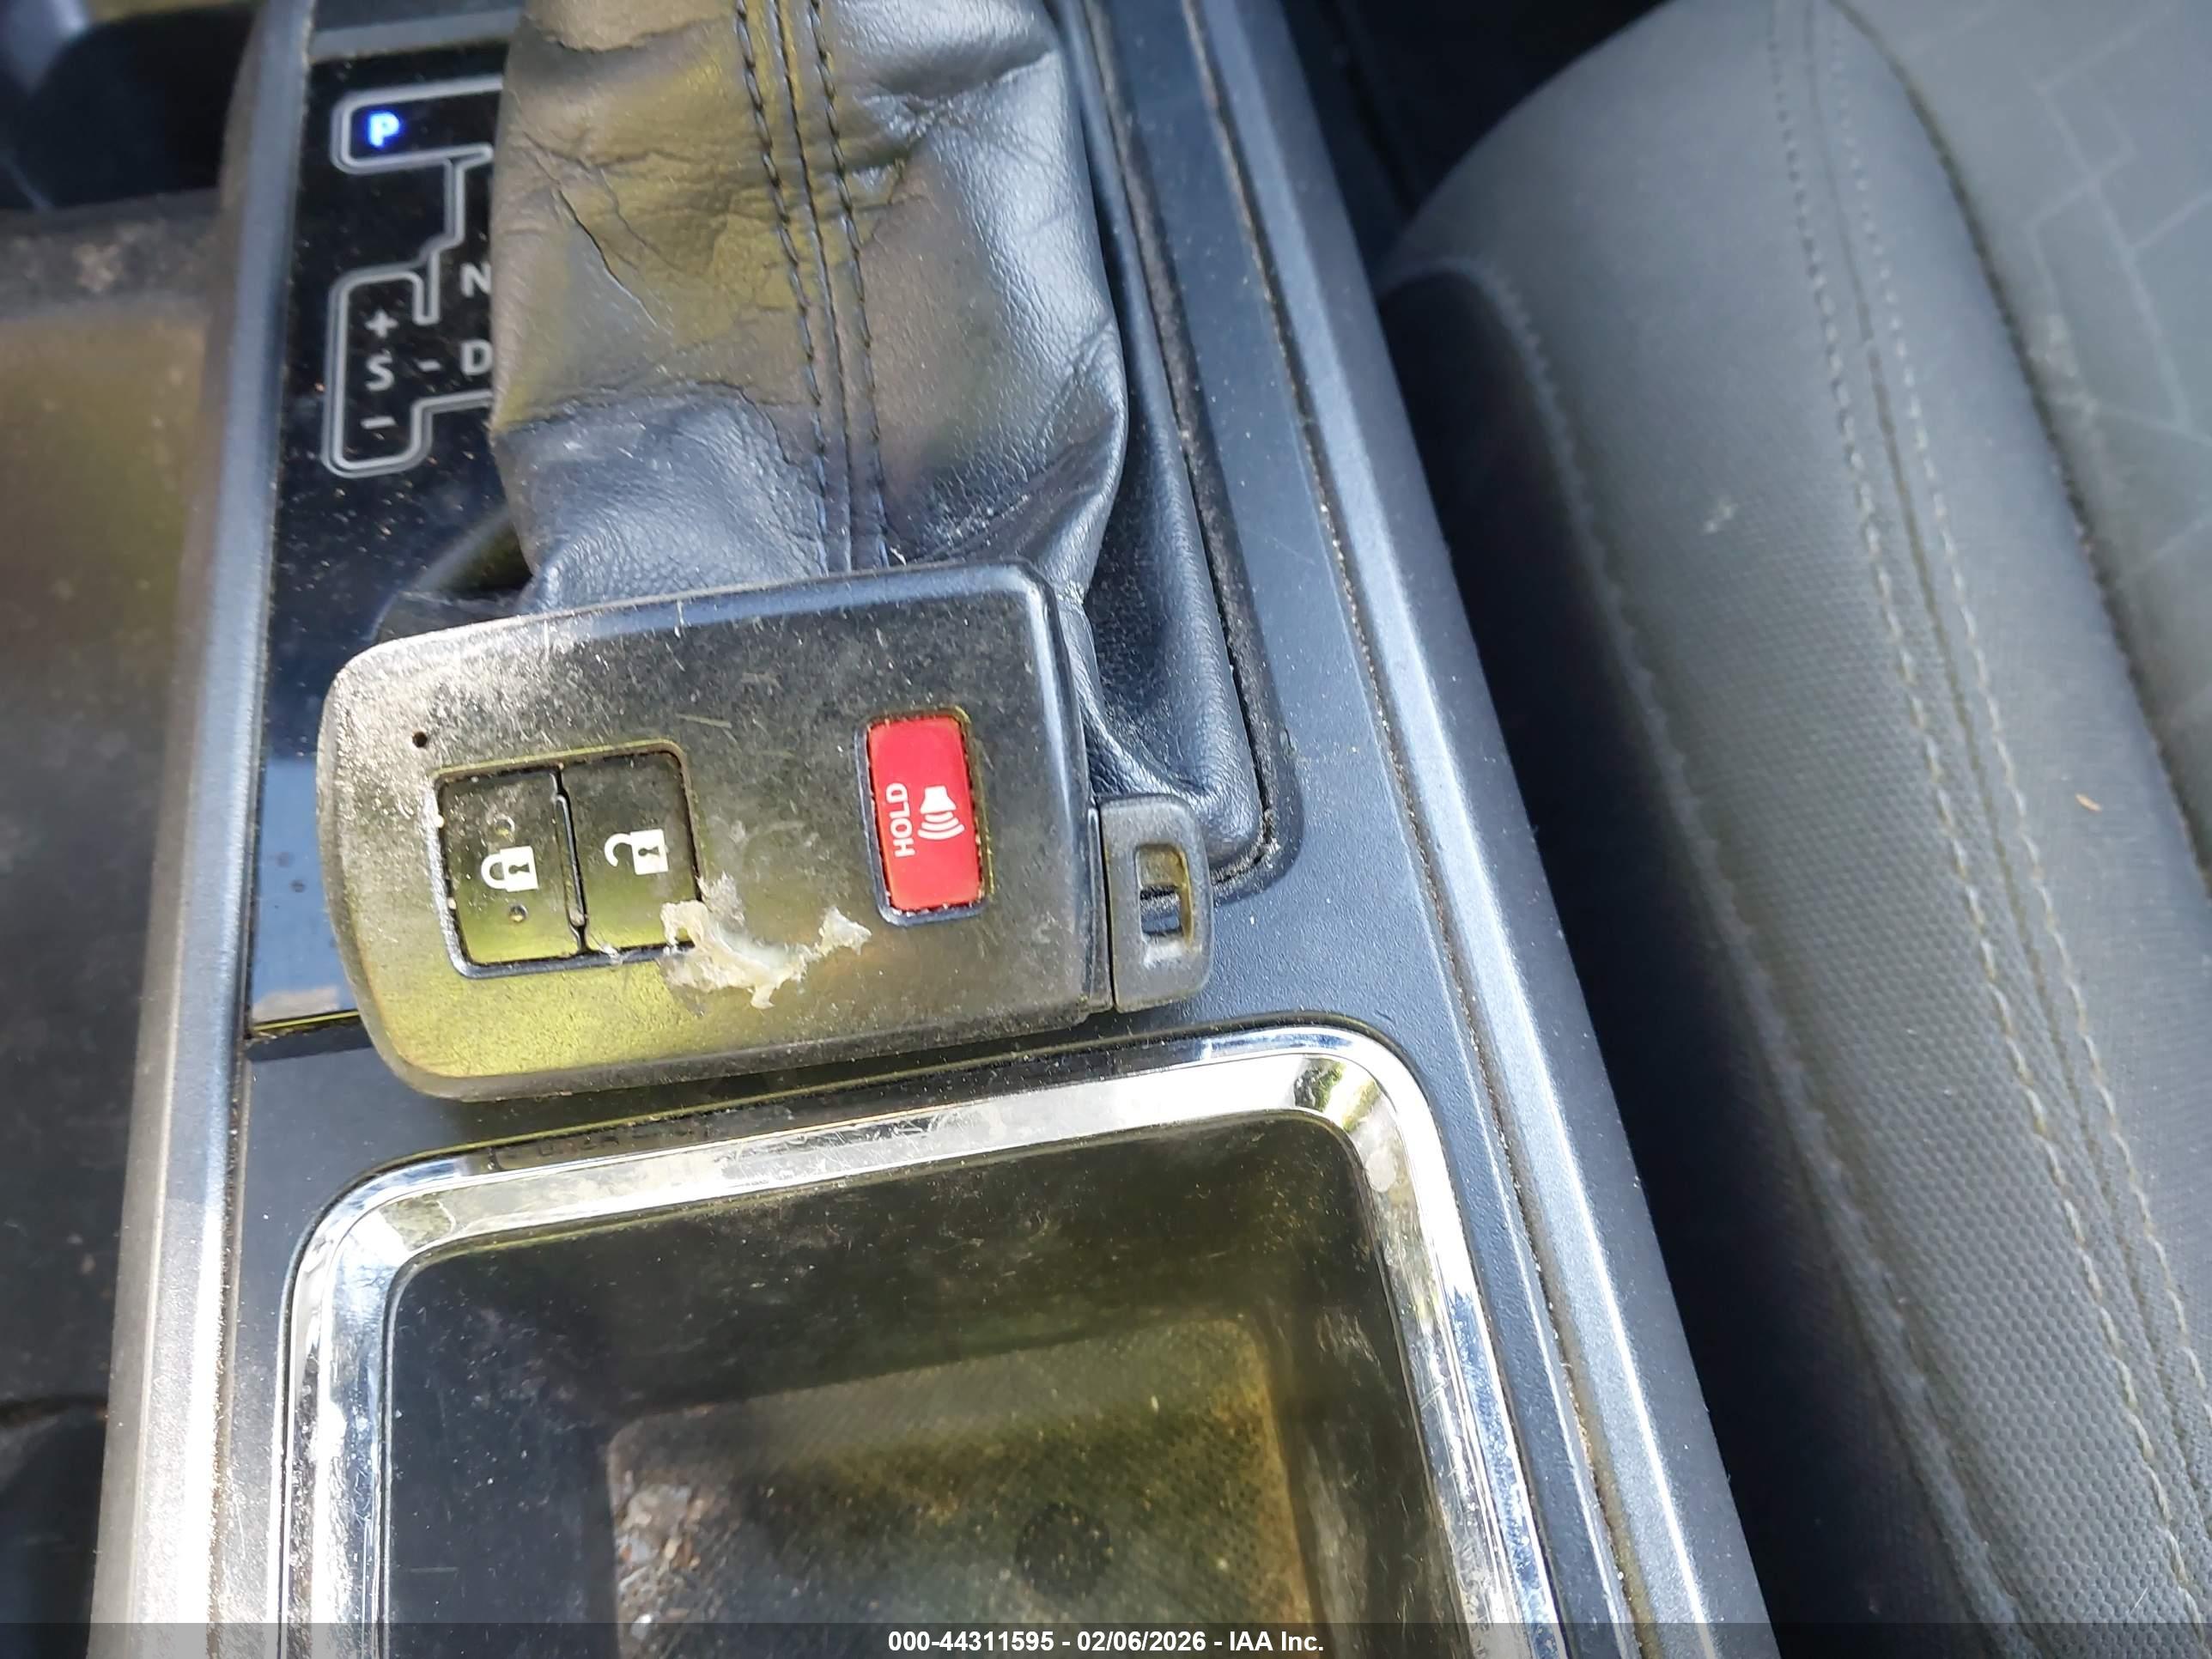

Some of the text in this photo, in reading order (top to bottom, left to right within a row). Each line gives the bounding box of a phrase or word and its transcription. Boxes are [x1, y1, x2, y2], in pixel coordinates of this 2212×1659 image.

[368, 112, 401, 148] P
[460, 262, 491, 298] N
[365, 307, 398, 337] +
[366, 352, 395, 392] S
[460, 339, 493, 376] D
[885, 782, 915, 858] HOLD
